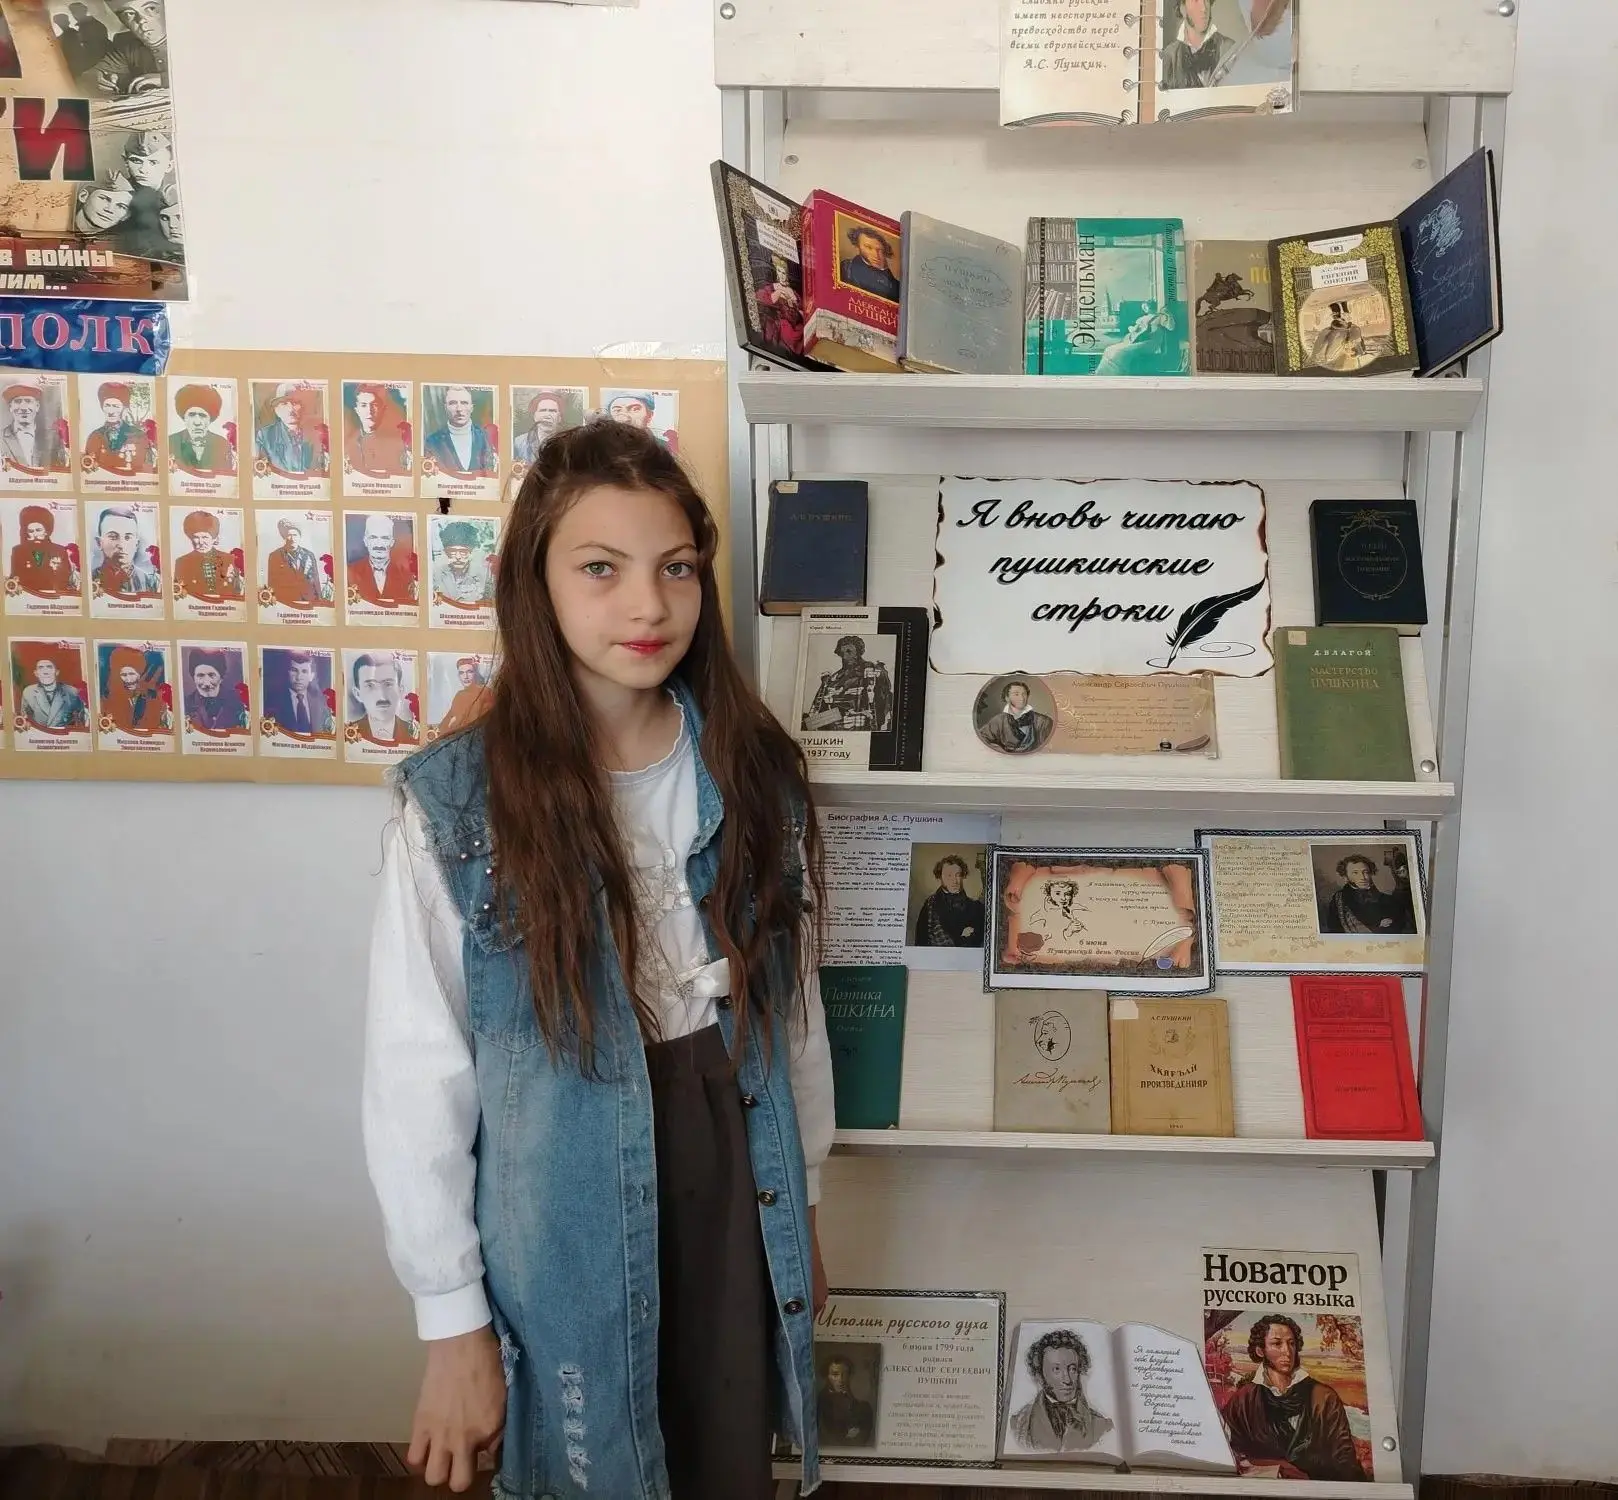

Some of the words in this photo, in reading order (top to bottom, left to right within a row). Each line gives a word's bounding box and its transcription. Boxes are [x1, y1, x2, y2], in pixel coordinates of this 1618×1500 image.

[1050, 12, 1117, 21] неоспоримое
[1011, 25, 1087, 37] превосходство
[1091, 25, 1119, 36] перед
[1010, 40, 1040, 49] всеми
[1044, 41, 1120, 52] европейскими.
[1024, 59, 1049, 69] А.С.
[1054, 58, 1107, 71] Пушкин.
[26, 245, 114, 267] ВОЙНЫ
[1071, 233, 1096, 349] Эйдельман
[848, 303, 897, 328] ПУШКИ
[0, 312, 154, 354] ПОЛК
[956, 498, 1001, 530] Я
[1004, 500, 1111, 530] вновь
[1121, 510, 1245, 531] читаю
[988, 556, 1214, 585] пушкинские
[1031, 597, 1175, 633] строки
[1311, 666, 1378, 675] МАСТЕРСТВО
[1311, 678, 1379, 689] ПУШКИНА
[829, 751, 851, 759] году
[828, 813, 879, 823] Биография
[882, 814, 900, 822] А.С.
[903, 815, 944, 824] Пушкина
[1046, 948, 1092, 956] Пушкинский
[824, 987, 882, 1001] Поэтика
[1140, 1080, 1208, 1089] ПРОИЗВЕДЕНИЯР
[1203, 1253, 1347, 1290] Новатор
[1203, 1288, 1287, 1306] русского
[1293, 1291, 1355, 1307] языка
[817, 1304, 883, 1328] Исполин
[886, 1318, 950, 1335] русского
[955, 1320, 988, 1336] духа
[907, 1344, 932, 1352] июня
[935, 1343, 954, 1351] 1799
[1134, 1345, 1143, 1354] Я
[922, 1356, 953, 1364] родился
[883, 1365, 936, 1373] АЛЕКСАНДР
[940, 1366, 991, 1375] СЕРГЕЕВИЧ
[917, 1377, 958, 1385] ПУШКИН
